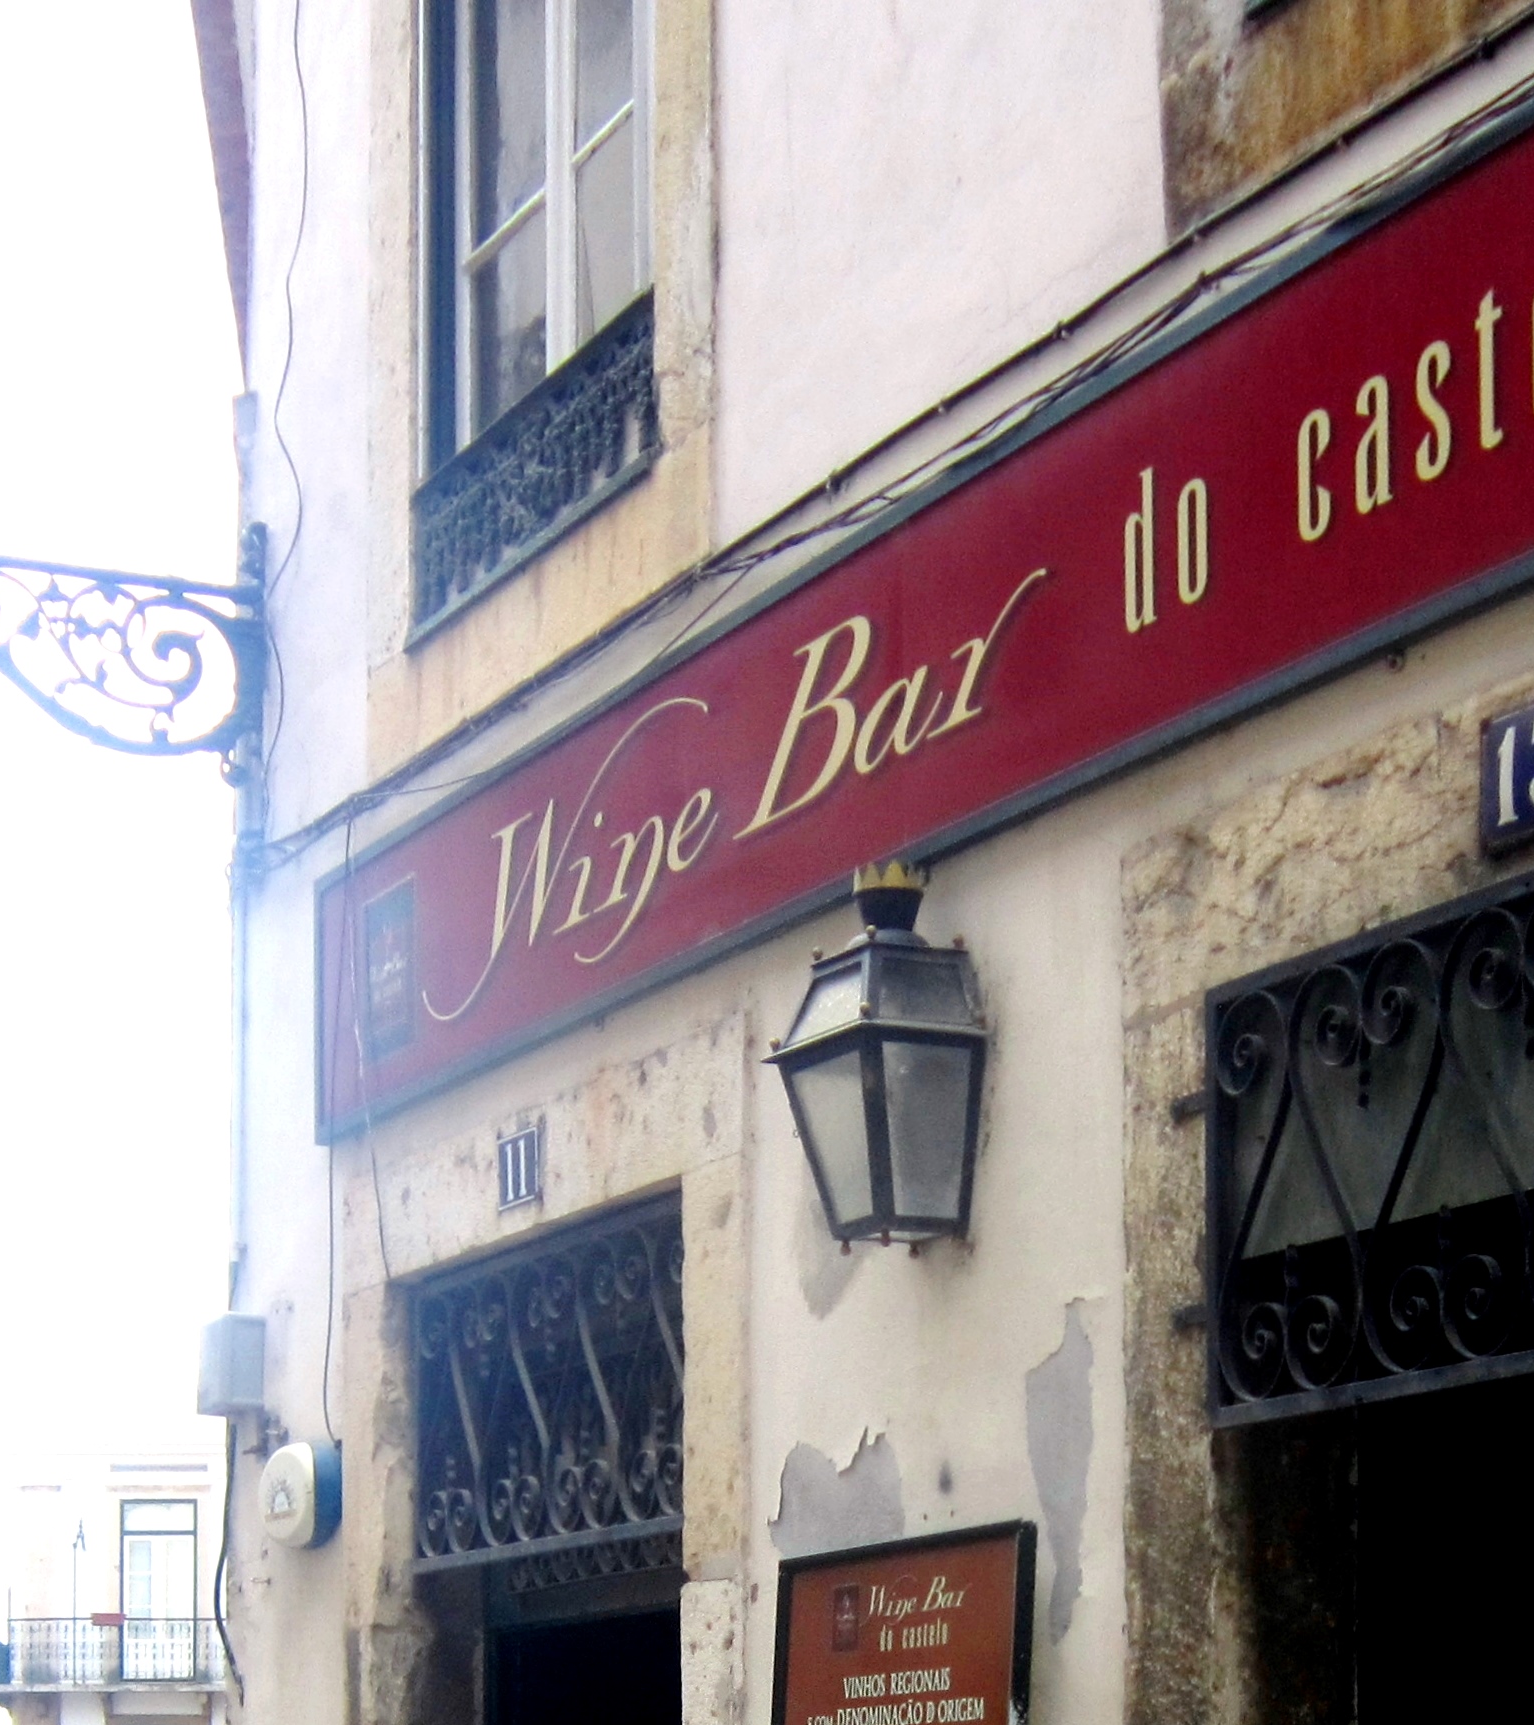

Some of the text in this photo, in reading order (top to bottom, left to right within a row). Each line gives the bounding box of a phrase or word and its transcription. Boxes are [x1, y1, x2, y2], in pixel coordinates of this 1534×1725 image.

[422, 697, 718, 1022] Wine
[731, 567, 1047, 842] Bar
[1121, 465, 1210, 634] do
[504, 1137, 528, 1203] 11
[842, 1667, 952, 1700] VINHOS REGIONAIS
[937, 1697, 986, 1724] ORIGEM
